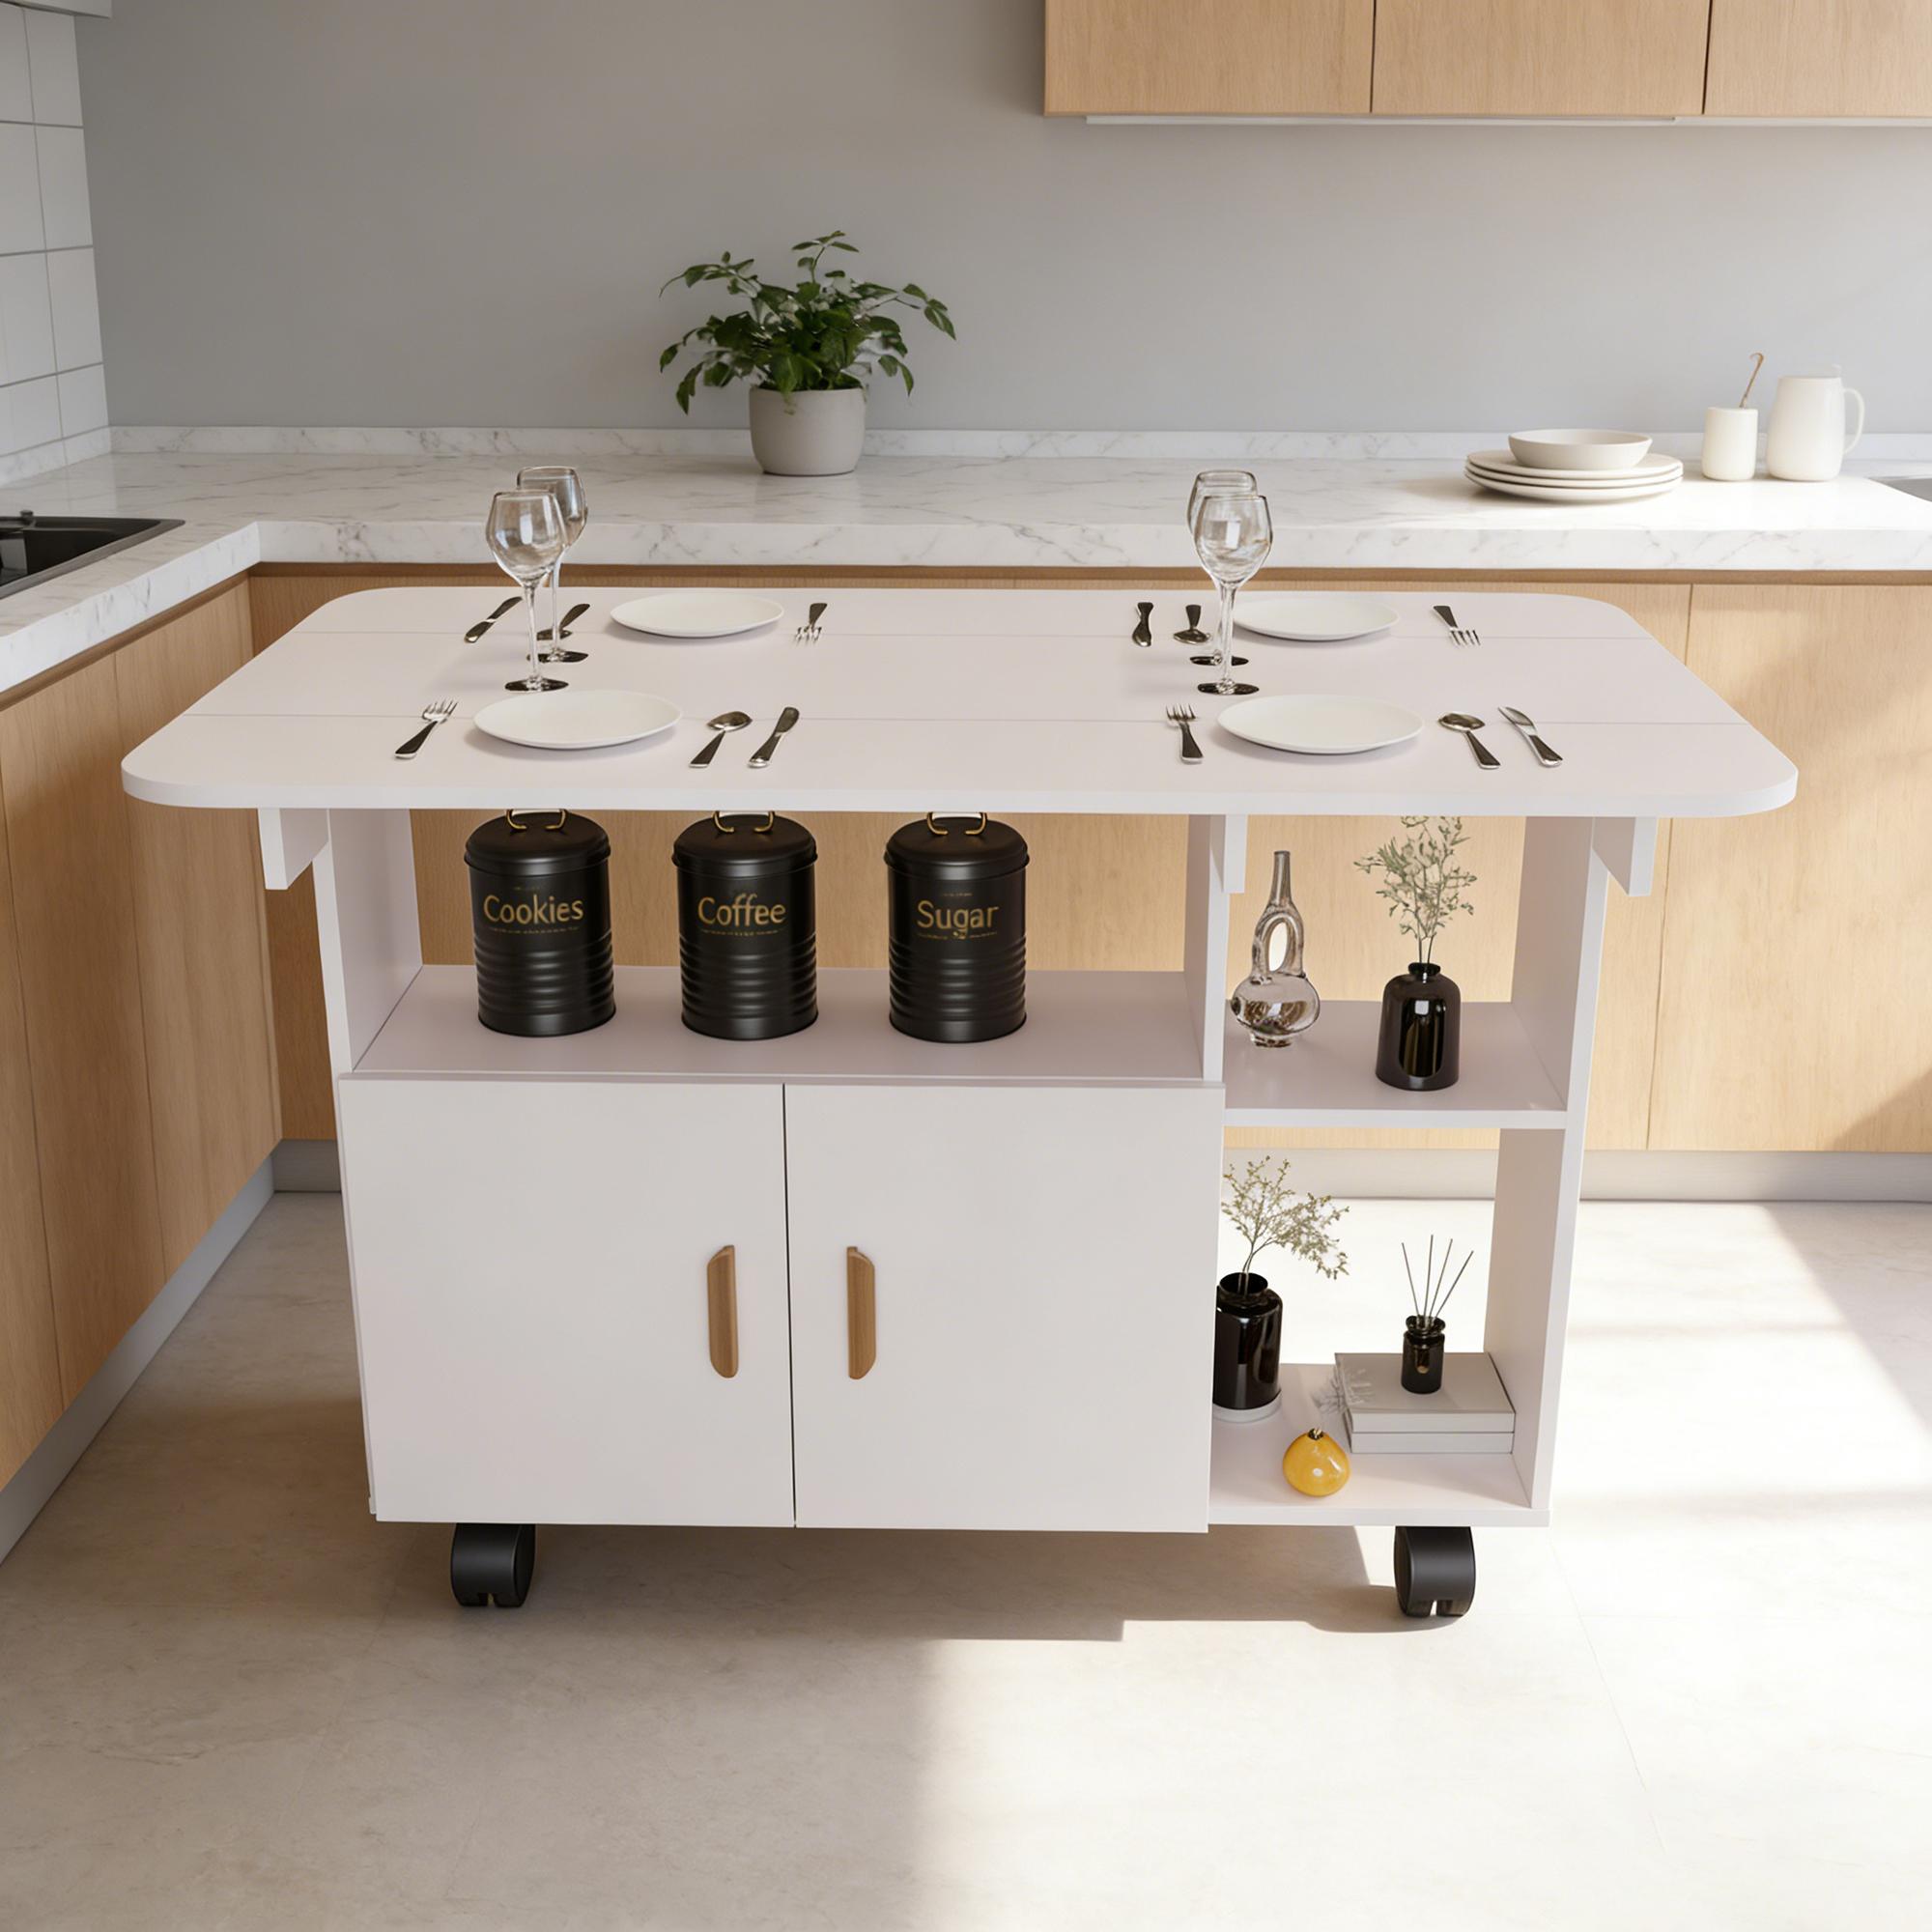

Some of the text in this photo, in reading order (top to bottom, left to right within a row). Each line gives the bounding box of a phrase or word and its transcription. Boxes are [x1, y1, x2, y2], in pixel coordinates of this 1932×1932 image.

[483, 894, 583, 924] Cookies
[697, 893, 786, 927] Coffee
[917, 899, 1000, 940] Sugar
